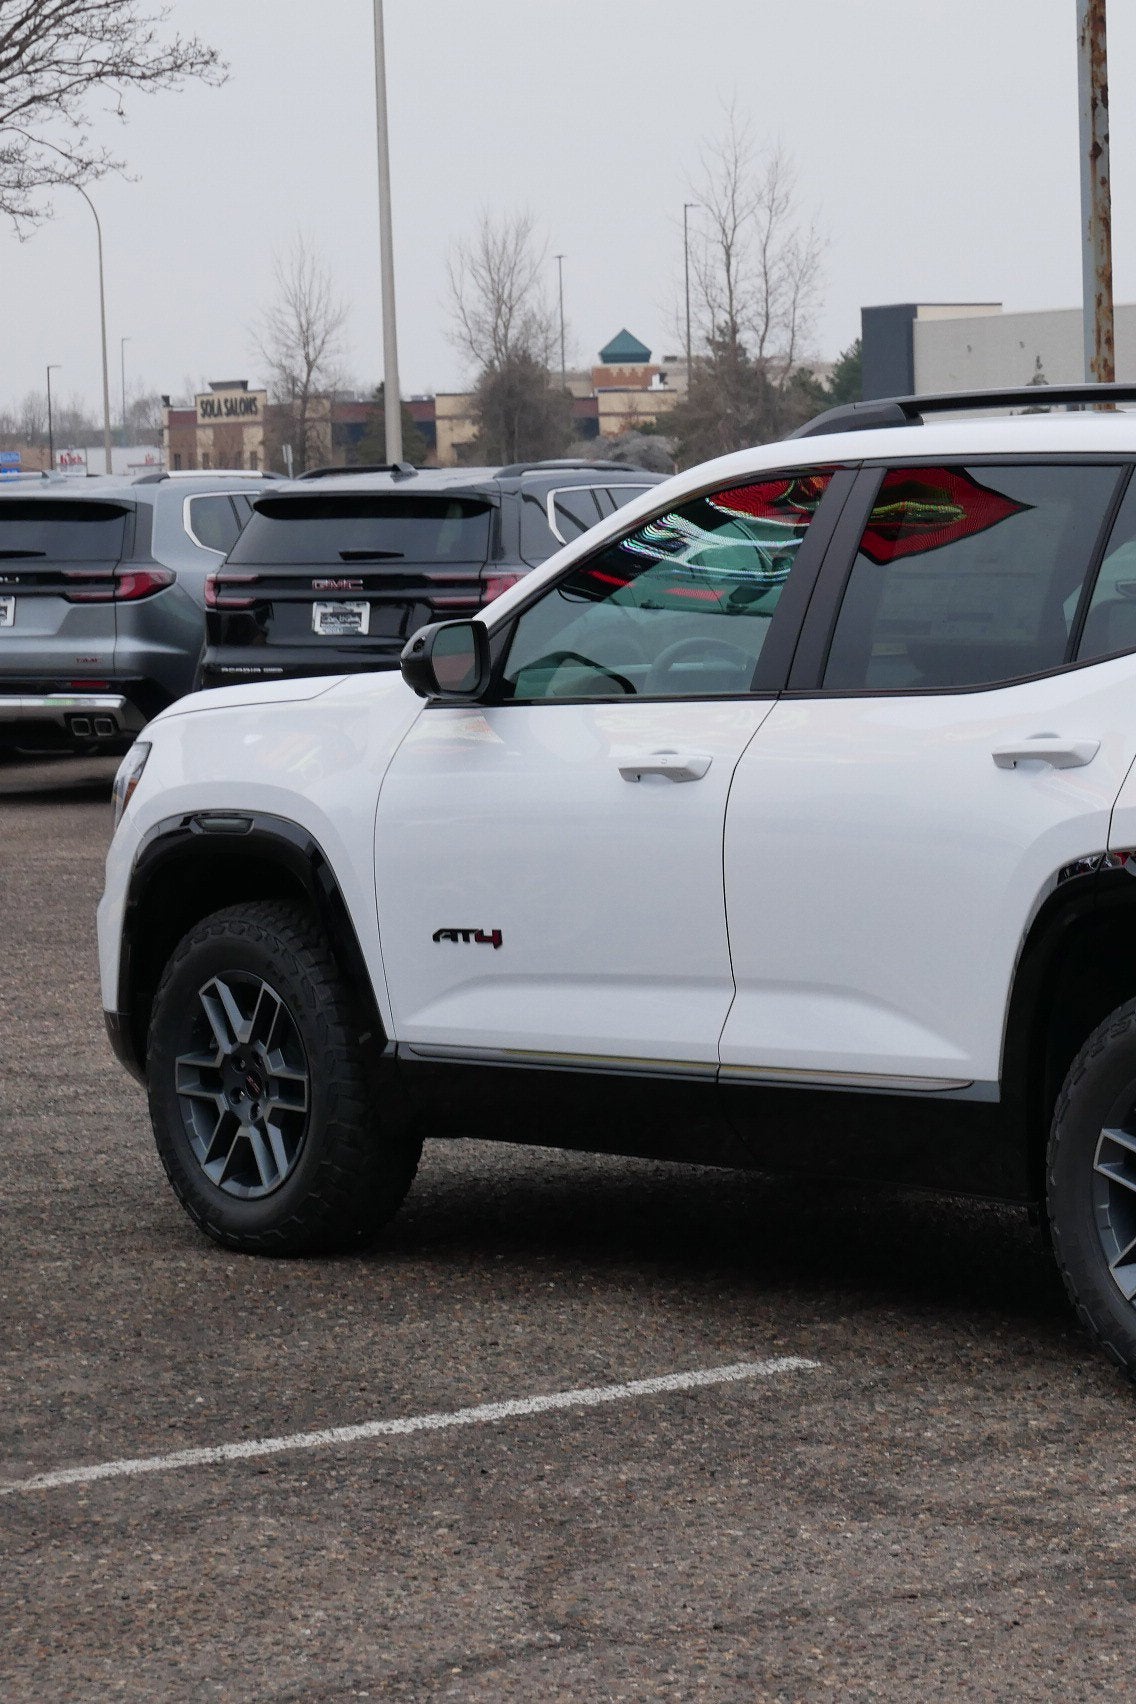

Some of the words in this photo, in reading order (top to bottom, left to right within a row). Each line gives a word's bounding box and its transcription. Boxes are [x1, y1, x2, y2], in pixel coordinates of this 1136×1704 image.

[201, 399, 222, 418] SOLA
[224, 396, 258, 416] SALONS
[432, 928, 503, 950] AT4
